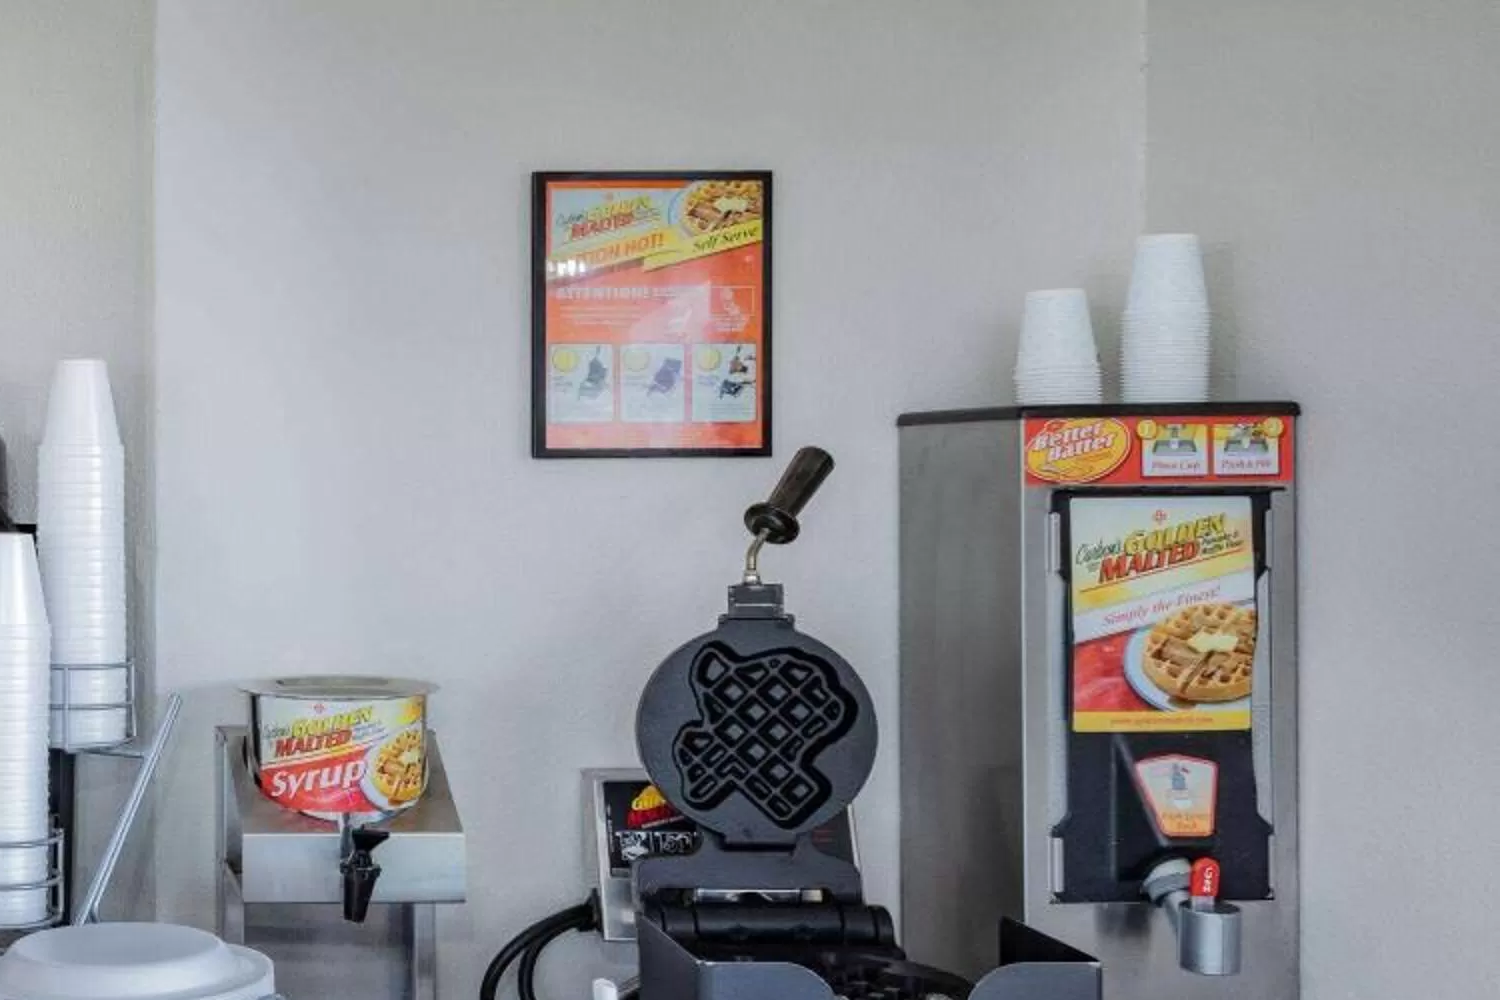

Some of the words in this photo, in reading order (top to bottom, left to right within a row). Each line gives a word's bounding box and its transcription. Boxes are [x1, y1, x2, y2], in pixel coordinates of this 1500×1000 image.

[622, 233, 665, 256] HOT!
[693, 237, 719, 253] Self
[721, 225, 759, 243] Serve
[1033, 422, 1103, 451] Better
[1047, 433, 1117, 462] Batter
[1123, 512, 1225, 553] GOLDEN
[1097, 539, 1199, 584] MALTED
[1152, 602, 1175, 613] the
[291, 705, 373, 738] GOLDEN
[274, 728, 352, 758] MALTED
[271, 759, 367, 800] Syrup
